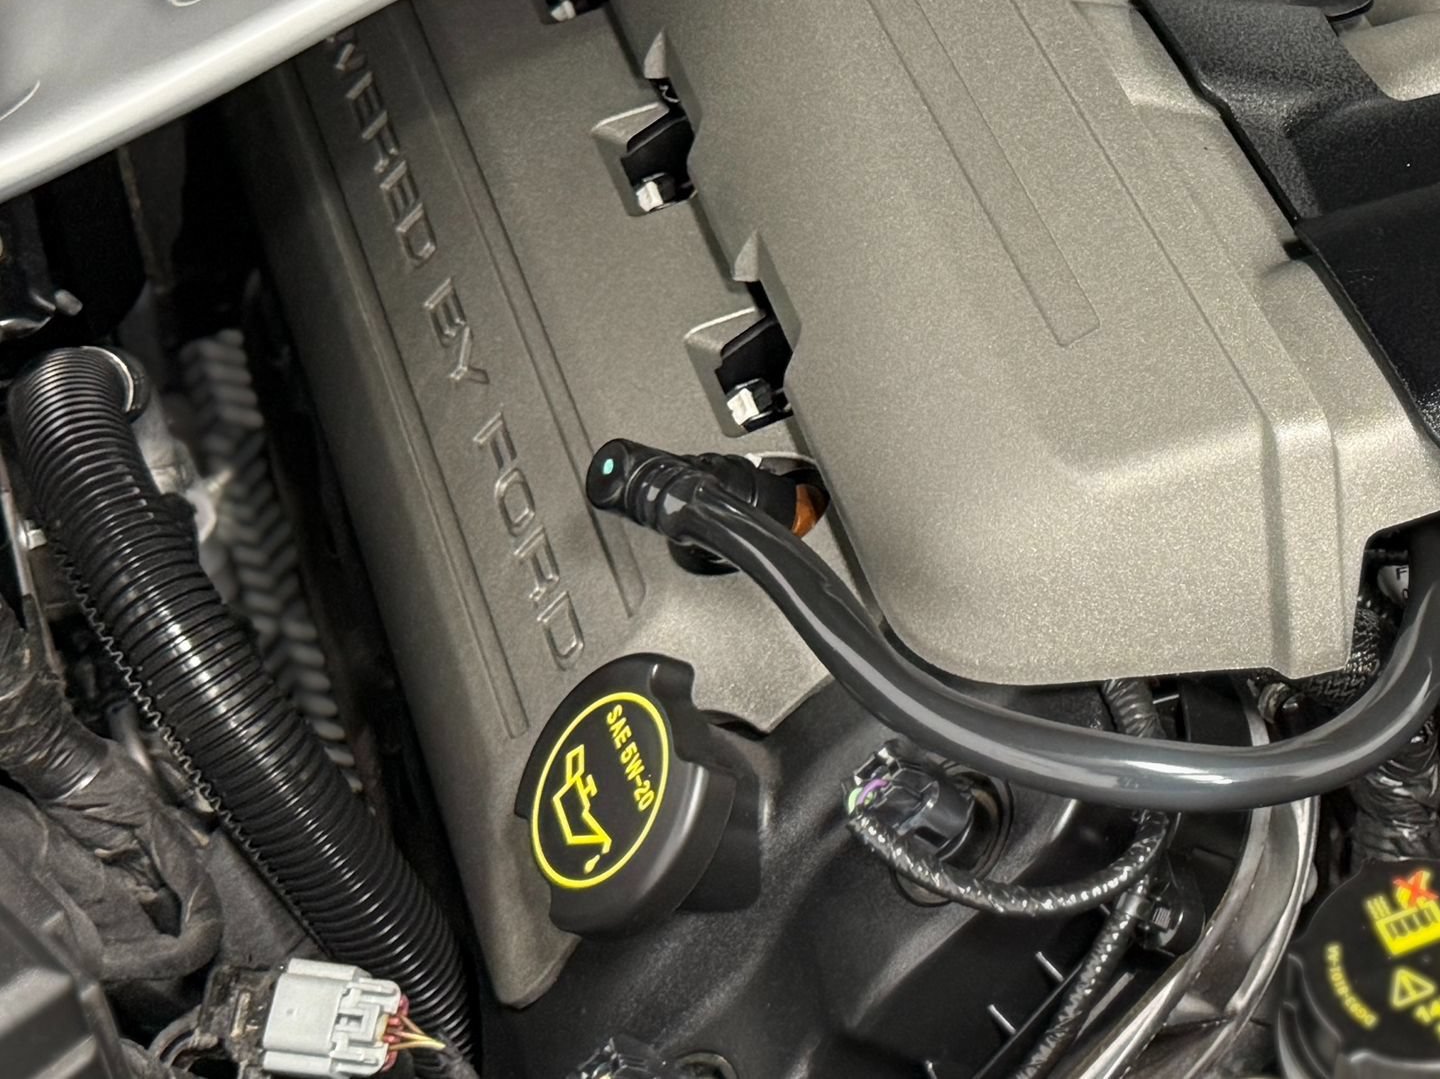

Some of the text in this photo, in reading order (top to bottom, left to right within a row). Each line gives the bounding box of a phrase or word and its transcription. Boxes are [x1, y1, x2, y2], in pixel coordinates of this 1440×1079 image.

[423, 277, 491, 385] BY
[472, 409, 585, 672] FORD
[603, 703, 656, 812] SAE 5W-20
